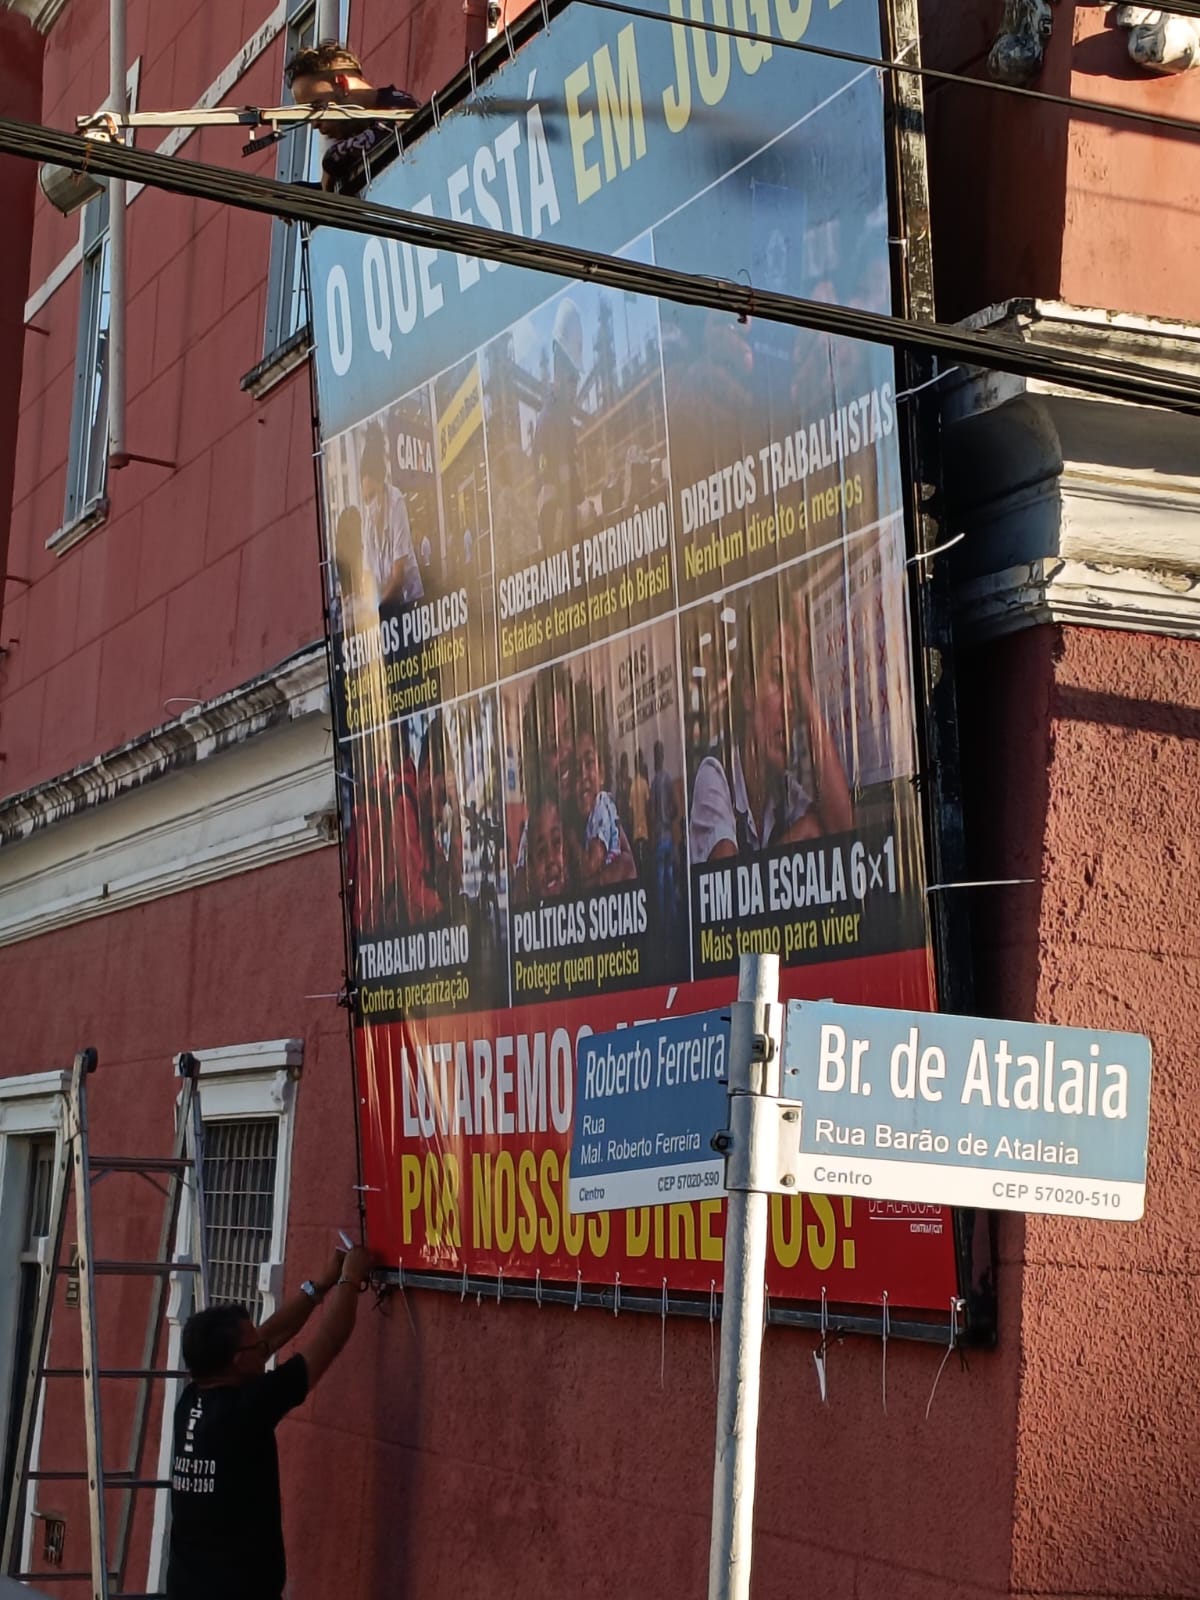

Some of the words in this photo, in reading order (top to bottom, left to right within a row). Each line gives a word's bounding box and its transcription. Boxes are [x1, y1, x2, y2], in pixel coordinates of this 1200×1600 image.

[326, 265, 352, 376] O
[363, 194, 444, 360] QUE
[447, 69, 561, 292] ESTÁ
[564, 23, 647, 204] EM
[397, 433, 433, 473] CAIXA
[681, 455, 756, 534] DIREITOS
[759, 382, 894, 491] TRABALHISTAS
[684, 535, 744, 581] Nenhum
[747, 501, 795, 554] direito
[798, 503, 808, 528] a
[812, 474, 863, 524] menos
[499, 558, 571, 620] SOBERANIA
[572, 544, 582, 587] E
[584, 502, 669, 583] PATRIMÔNIO
[402, 587, 468, 648] PÚBLICOS
[502, 612, 544, 659] Estatais
[546, 617, 553, 631] e
[554, 599, 587, 629] terras
[588, 588, 617, 623] raras
[619, 577, 634, 614] do
[637, 555, 671, 604] Brasil
[421, 636, 465, 680] públicos
[387, 676, 438, 714] desmonte
[700, 868, 733, 924] FIM
[737, 865, 764, 917] DA
[769, 846, 847, 913] ESCALA
[514, 901, 586, 954] POLÍTICAS
[588, 888, 647, 941] SOCIAIS
[701, 926, 733, 964] Mais
[784, 919, 818, 961] para
[823, 906, 861, 943] viver
[359, 932, 426, 981] TRABALHO
[429, 924, 469, 970] DIGNO
[515, 956, 562, 994] Proteger
[564, 957, 596, 992] quem
[598, 942, 640, 988] precisa
[361, 986, 395, 1014] Contra
[397, 993, 404, 1009] a
[405, 970, 470, 1014] precarização
[400, 1025, 594, 1138] LUTAREMO
[585, 1039, 651, 1100] Roberto
[656, 1022, 726, 1088] Ferreira
[817, 1023, 872, 1097] Br.
[890, 1027, 946, 1102] de
[960, 1038, 1129, 1120] Atalaia
[580, 1143, 604, 1166] Mal.
[607, 1136, 652, 1162] Roberto
[655, 1128, 700, 1154] Ferreira
[582, 1115, 605, 1137] Rua
[815, 1119, 866, 1146] Rua
[875, 1124, 949, 1154] Barão
[957, 1132, 988, 1158] de
[994, 1135, 1080, 1166] Atalaia
[401, 1150, 462, 1248] POR
[579, 1186, 605, 1202] Centro
[657, 1175, 675, 1193] CEP
[677, 1170, 720, 1190] 57020-590
[814, 1166, 873, 1187] Centro
[992, 1181, 1029, 1200] CEP
[1034, 1186, 1121, 1209] 57020-510
